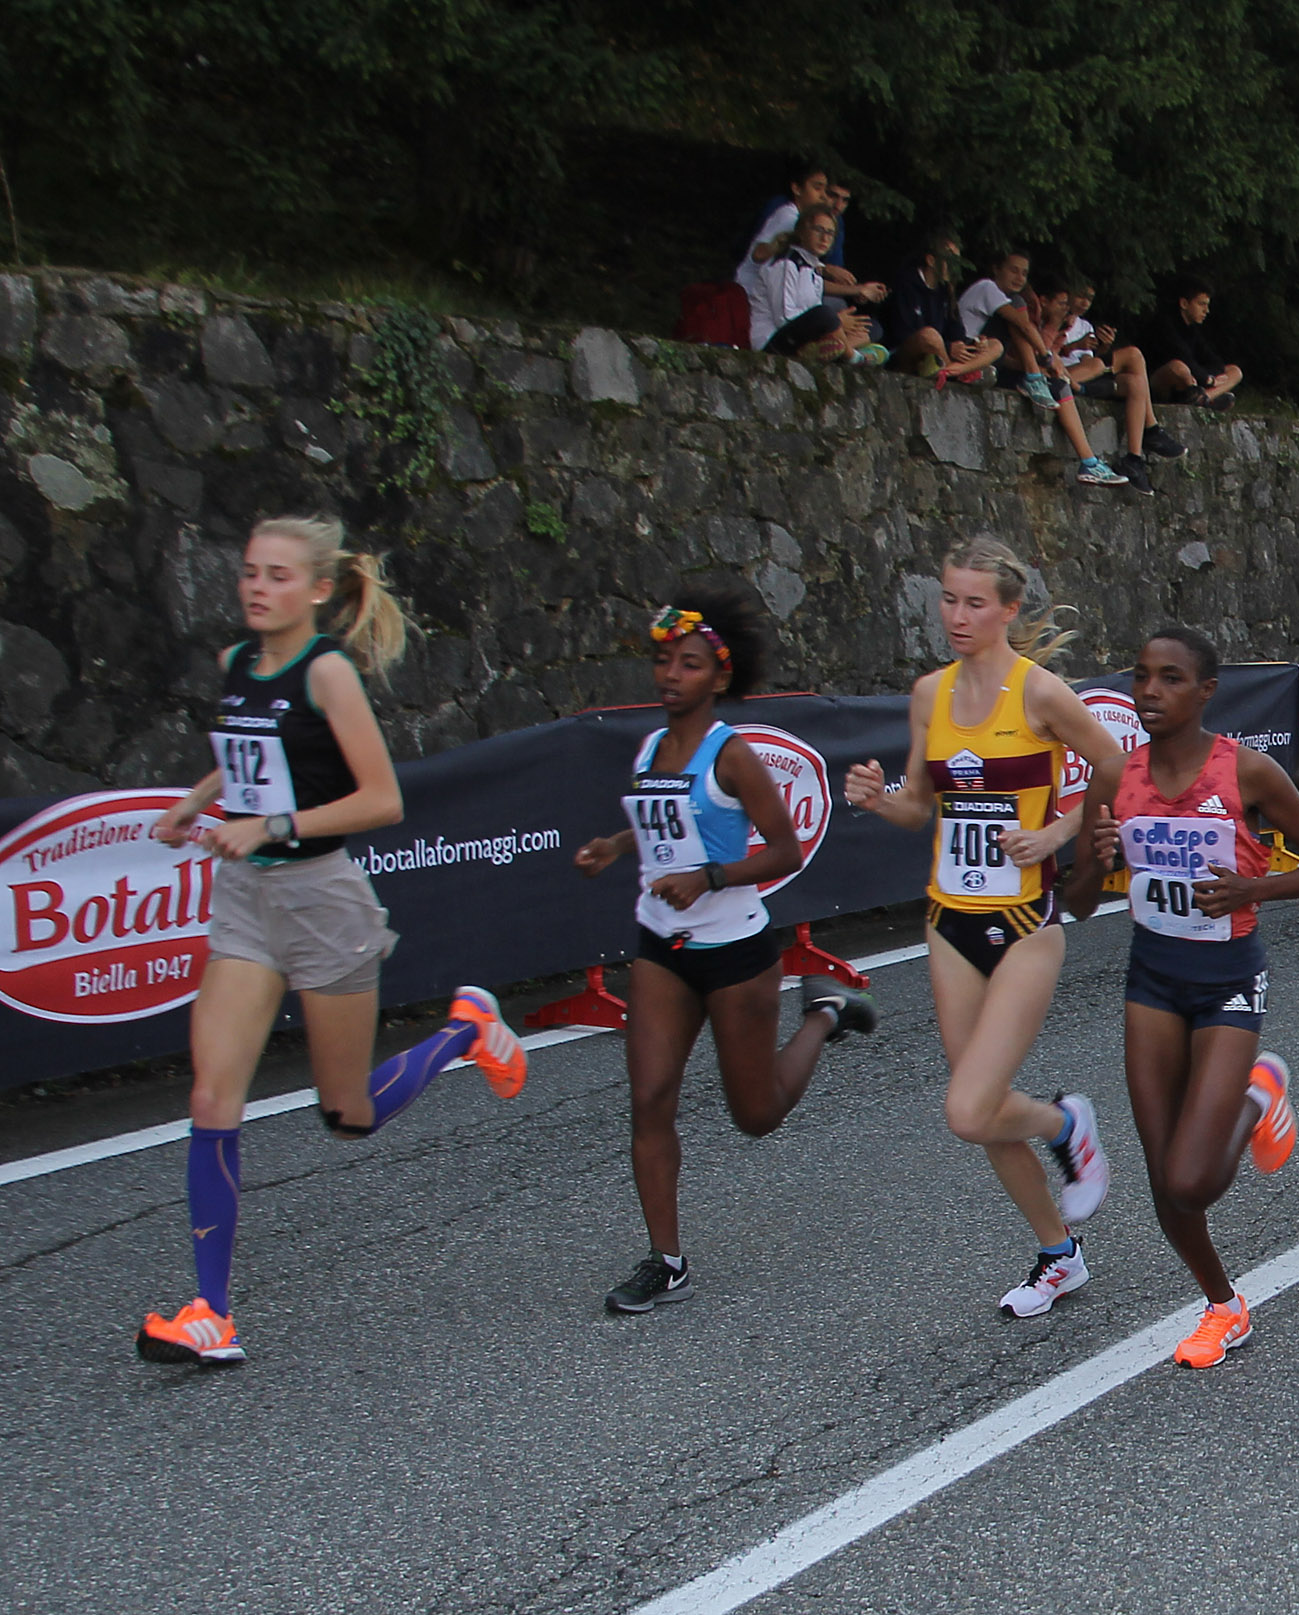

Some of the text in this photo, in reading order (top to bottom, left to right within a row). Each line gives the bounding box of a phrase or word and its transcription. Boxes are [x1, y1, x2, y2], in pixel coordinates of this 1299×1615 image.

[1103, 710, 1140, 731] casearia
[225, 738, 272, 785] 412
[762, 752, 803, 778] asearia
[951, 768, 981, 777] PRAHA
[636, 799, 687, 841] 448
[953, 801, 1015, 813] DIADORA
[22, 820, 143, 874] Tradizione
[950, 822, 1006, 868] 408
[7, 855, 214, 953] Botall
[1146, 877, 1211, 917] 40
[74, 954, 193, 997] Biella 1947
